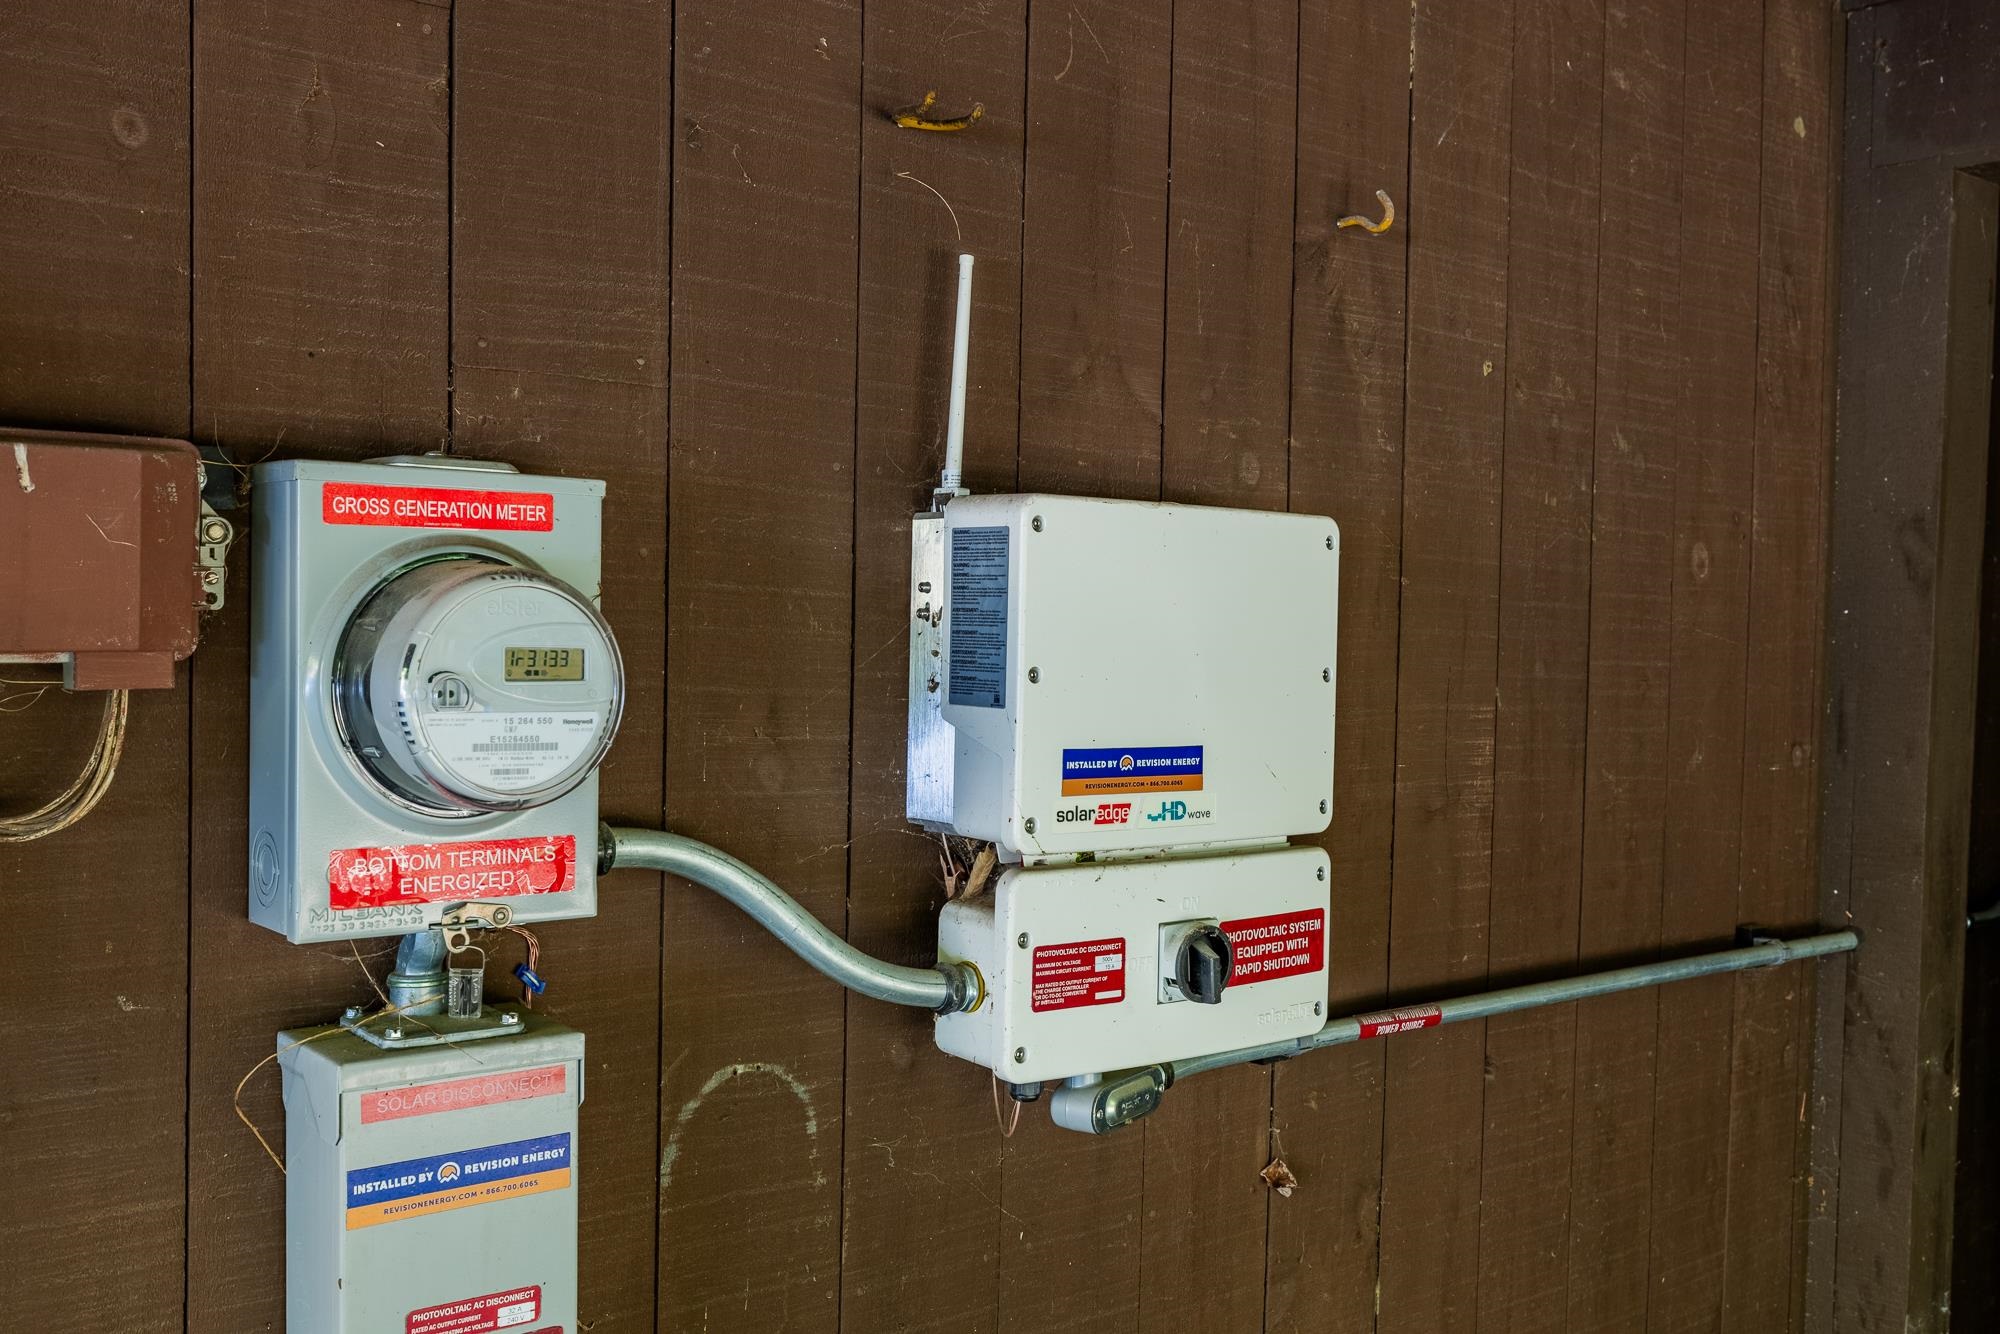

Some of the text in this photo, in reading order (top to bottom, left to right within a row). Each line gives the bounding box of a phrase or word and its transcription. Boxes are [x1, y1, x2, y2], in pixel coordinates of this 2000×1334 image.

[332, 496, 547, 522] GROSS GENERATION METER
[1066, 757, 1200, 769] INSTALLED BY REVISION ENERGY
[1085, 781, 1145, 789] REVISIONENERGY.COM
[1162, 801, 1211, 821] HD wave
[354, 846, 557, 874] BOTTOM TERMINALS
[400, 870, 515, 895] ENERGIZED
[310, 903, 423, 923] MILBANK
[1226, 919, 1321, 943] HOTOVOLTAIC SYSTEM
[1036, 947, 1078, 958] PHOTOVOLTAIC
[1088, 943, 1122, 952] DISCONNECT
[1237, 937, 1308, 959] EQUIPPED WITH
[1235, 953, 1310, 976] RAPID SHUTDOWN
[1376, 1020, 1426, 1035] POWER SOURCE
[377, 1074, 552, 1113] SOLAR DISCONNECT
[353, 1147, 566, 1195] INSTALLED BY REVISION ENERGY
[384, 1179, 539, 1215] REVISIONENERGY.COM 866.700.6065
[412, 1290, 535, 1323] PHOTOVOLTAIC AC DISCONNECT
[437, 1320, 457, 1330] OUTPUT
[457, 1314, 481, 1324] CURRENT
[472, 1321, 495, 1330] VOLTAGE
